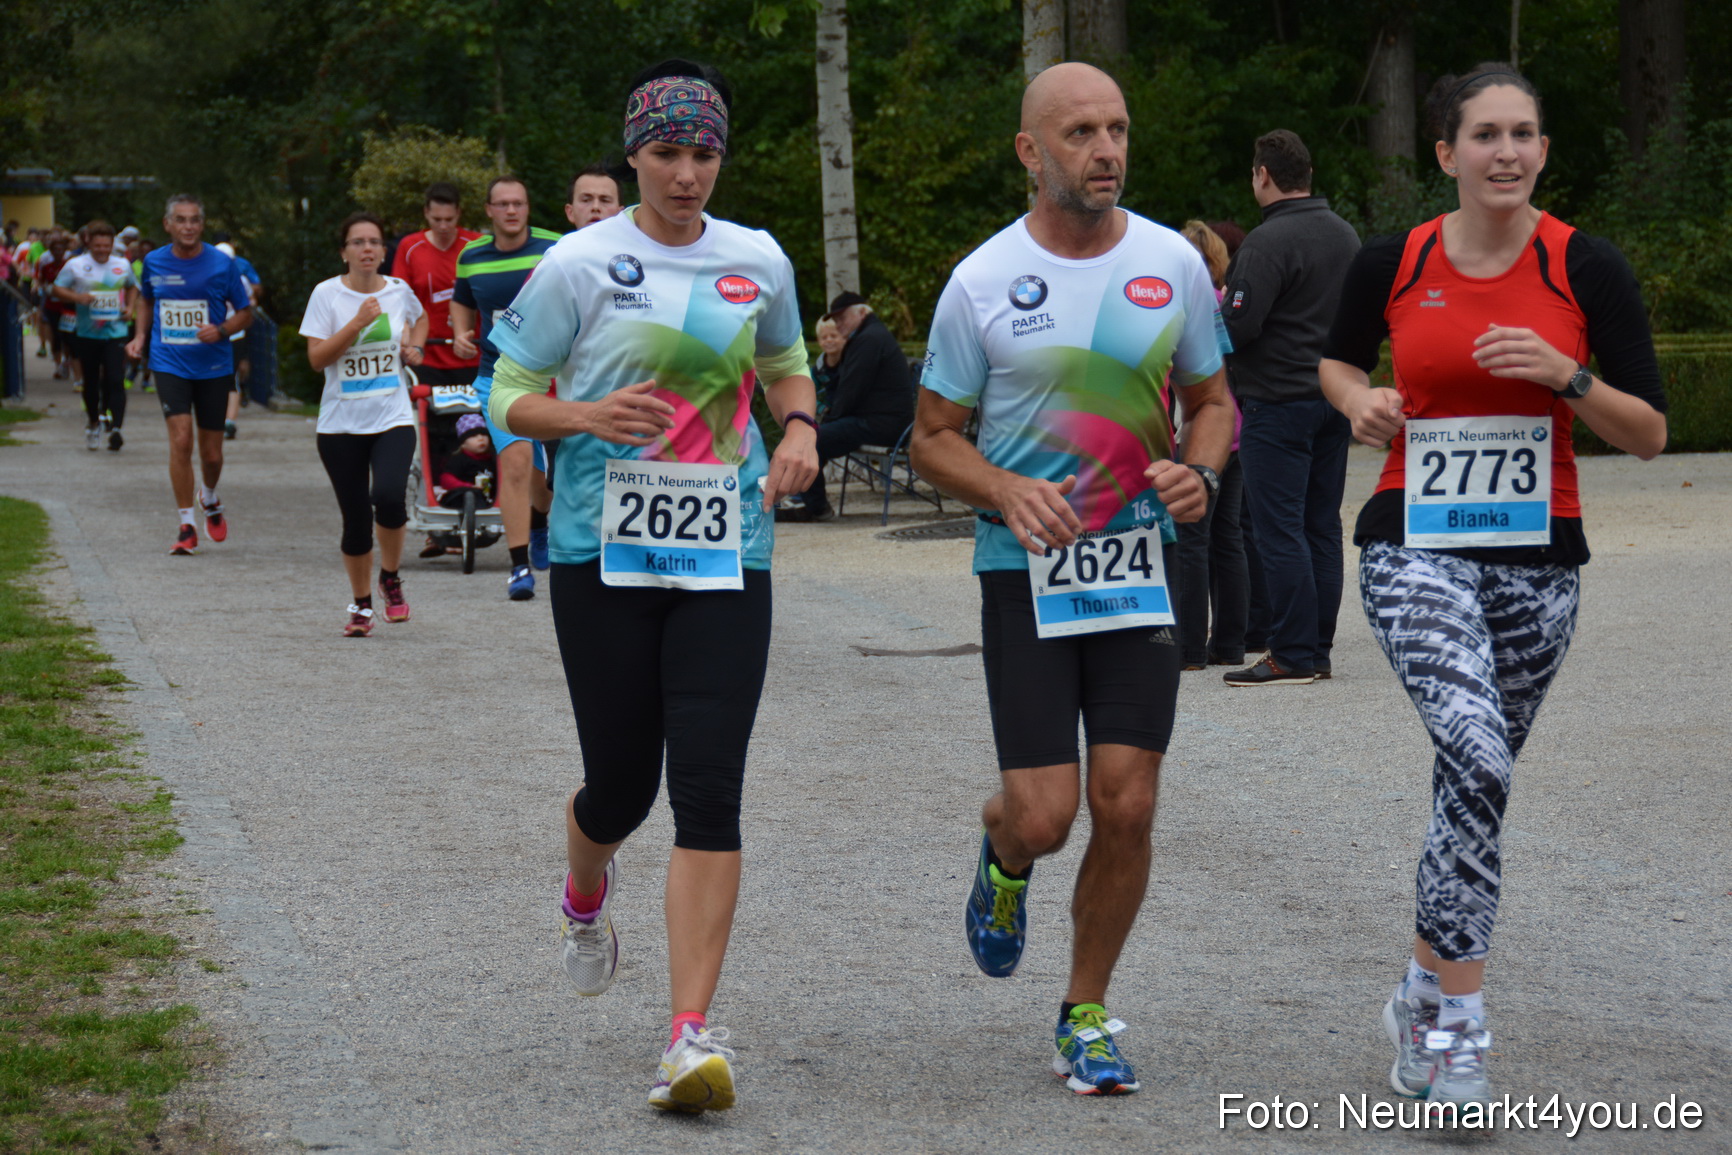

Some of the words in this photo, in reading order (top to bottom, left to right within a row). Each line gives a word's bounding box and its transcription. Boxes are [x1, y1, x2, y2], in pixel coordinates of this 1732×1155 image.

[610, 254, 641, 268] BMW
[721, 281, 756, 298] Hervis
[1010, 276, 1043, 290] BMW
[613, 292, 652, 302] PARTL
[1131, 284, 1168, 300] Hervis
[615, 302, 653, 310] Neumarkt
[1420, 299, 1445, 307] erima
[165, 310, 203, 327] 3109
[1012, 313, 1055, 330] PARTL
[1013, 322, 1056, 338] Neumarkt
[344, 354, 393, 377] 3012
[1410, 431, 1455, 443] PARTL
[1459, 429, 1526, 442] Neumarkt
[609, 471, 654, 486] PARTL
[658, 475, 719, 488] Neumarkt
[1421, 447, 1537, 496] 2773
[1411, 495, 1417, 503] D
[617, 492, 727, 542] 2623
[1132, 500, 1156, 520] 16.
[1447, 509, 1509, 528] Bianka
[646, 552, 697, 571] Katrin
[1044, 537, 1153, 587] 2624
[1038, 586, 1044, 594] B
[1070, 596, 1139, 615] Thomas
